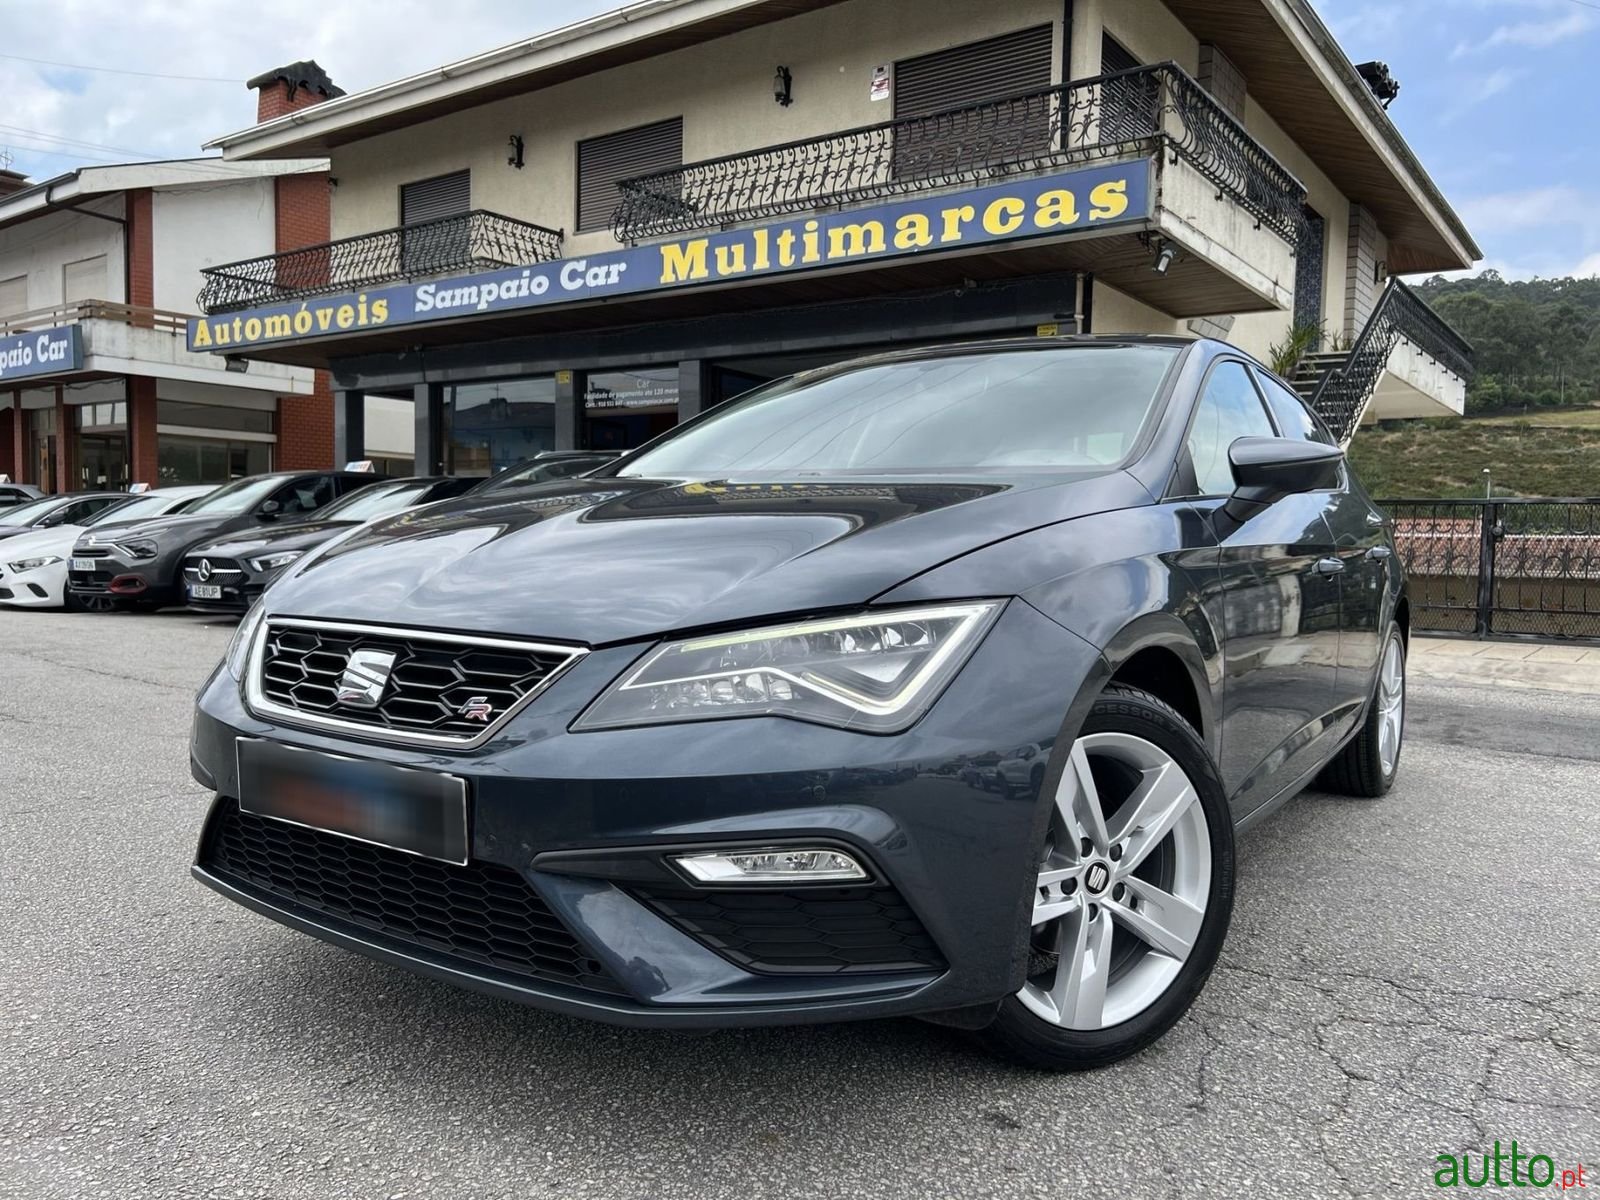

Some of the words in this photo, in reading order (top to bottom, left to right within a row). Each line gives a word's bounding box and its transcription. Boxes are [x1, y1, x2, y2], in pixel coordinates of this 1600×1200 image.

[193, 293, 389, 348] Automóveis
[414, 270, 550, 312] Sampaio
[560, 260, 627, 290] Car
[660, 179, 1128, 284] Multimarcas
[36, 334, 68, 363] Car
[636, 378, 651, 389] Car
[1093, 703, 1165, 725] CESSOR
